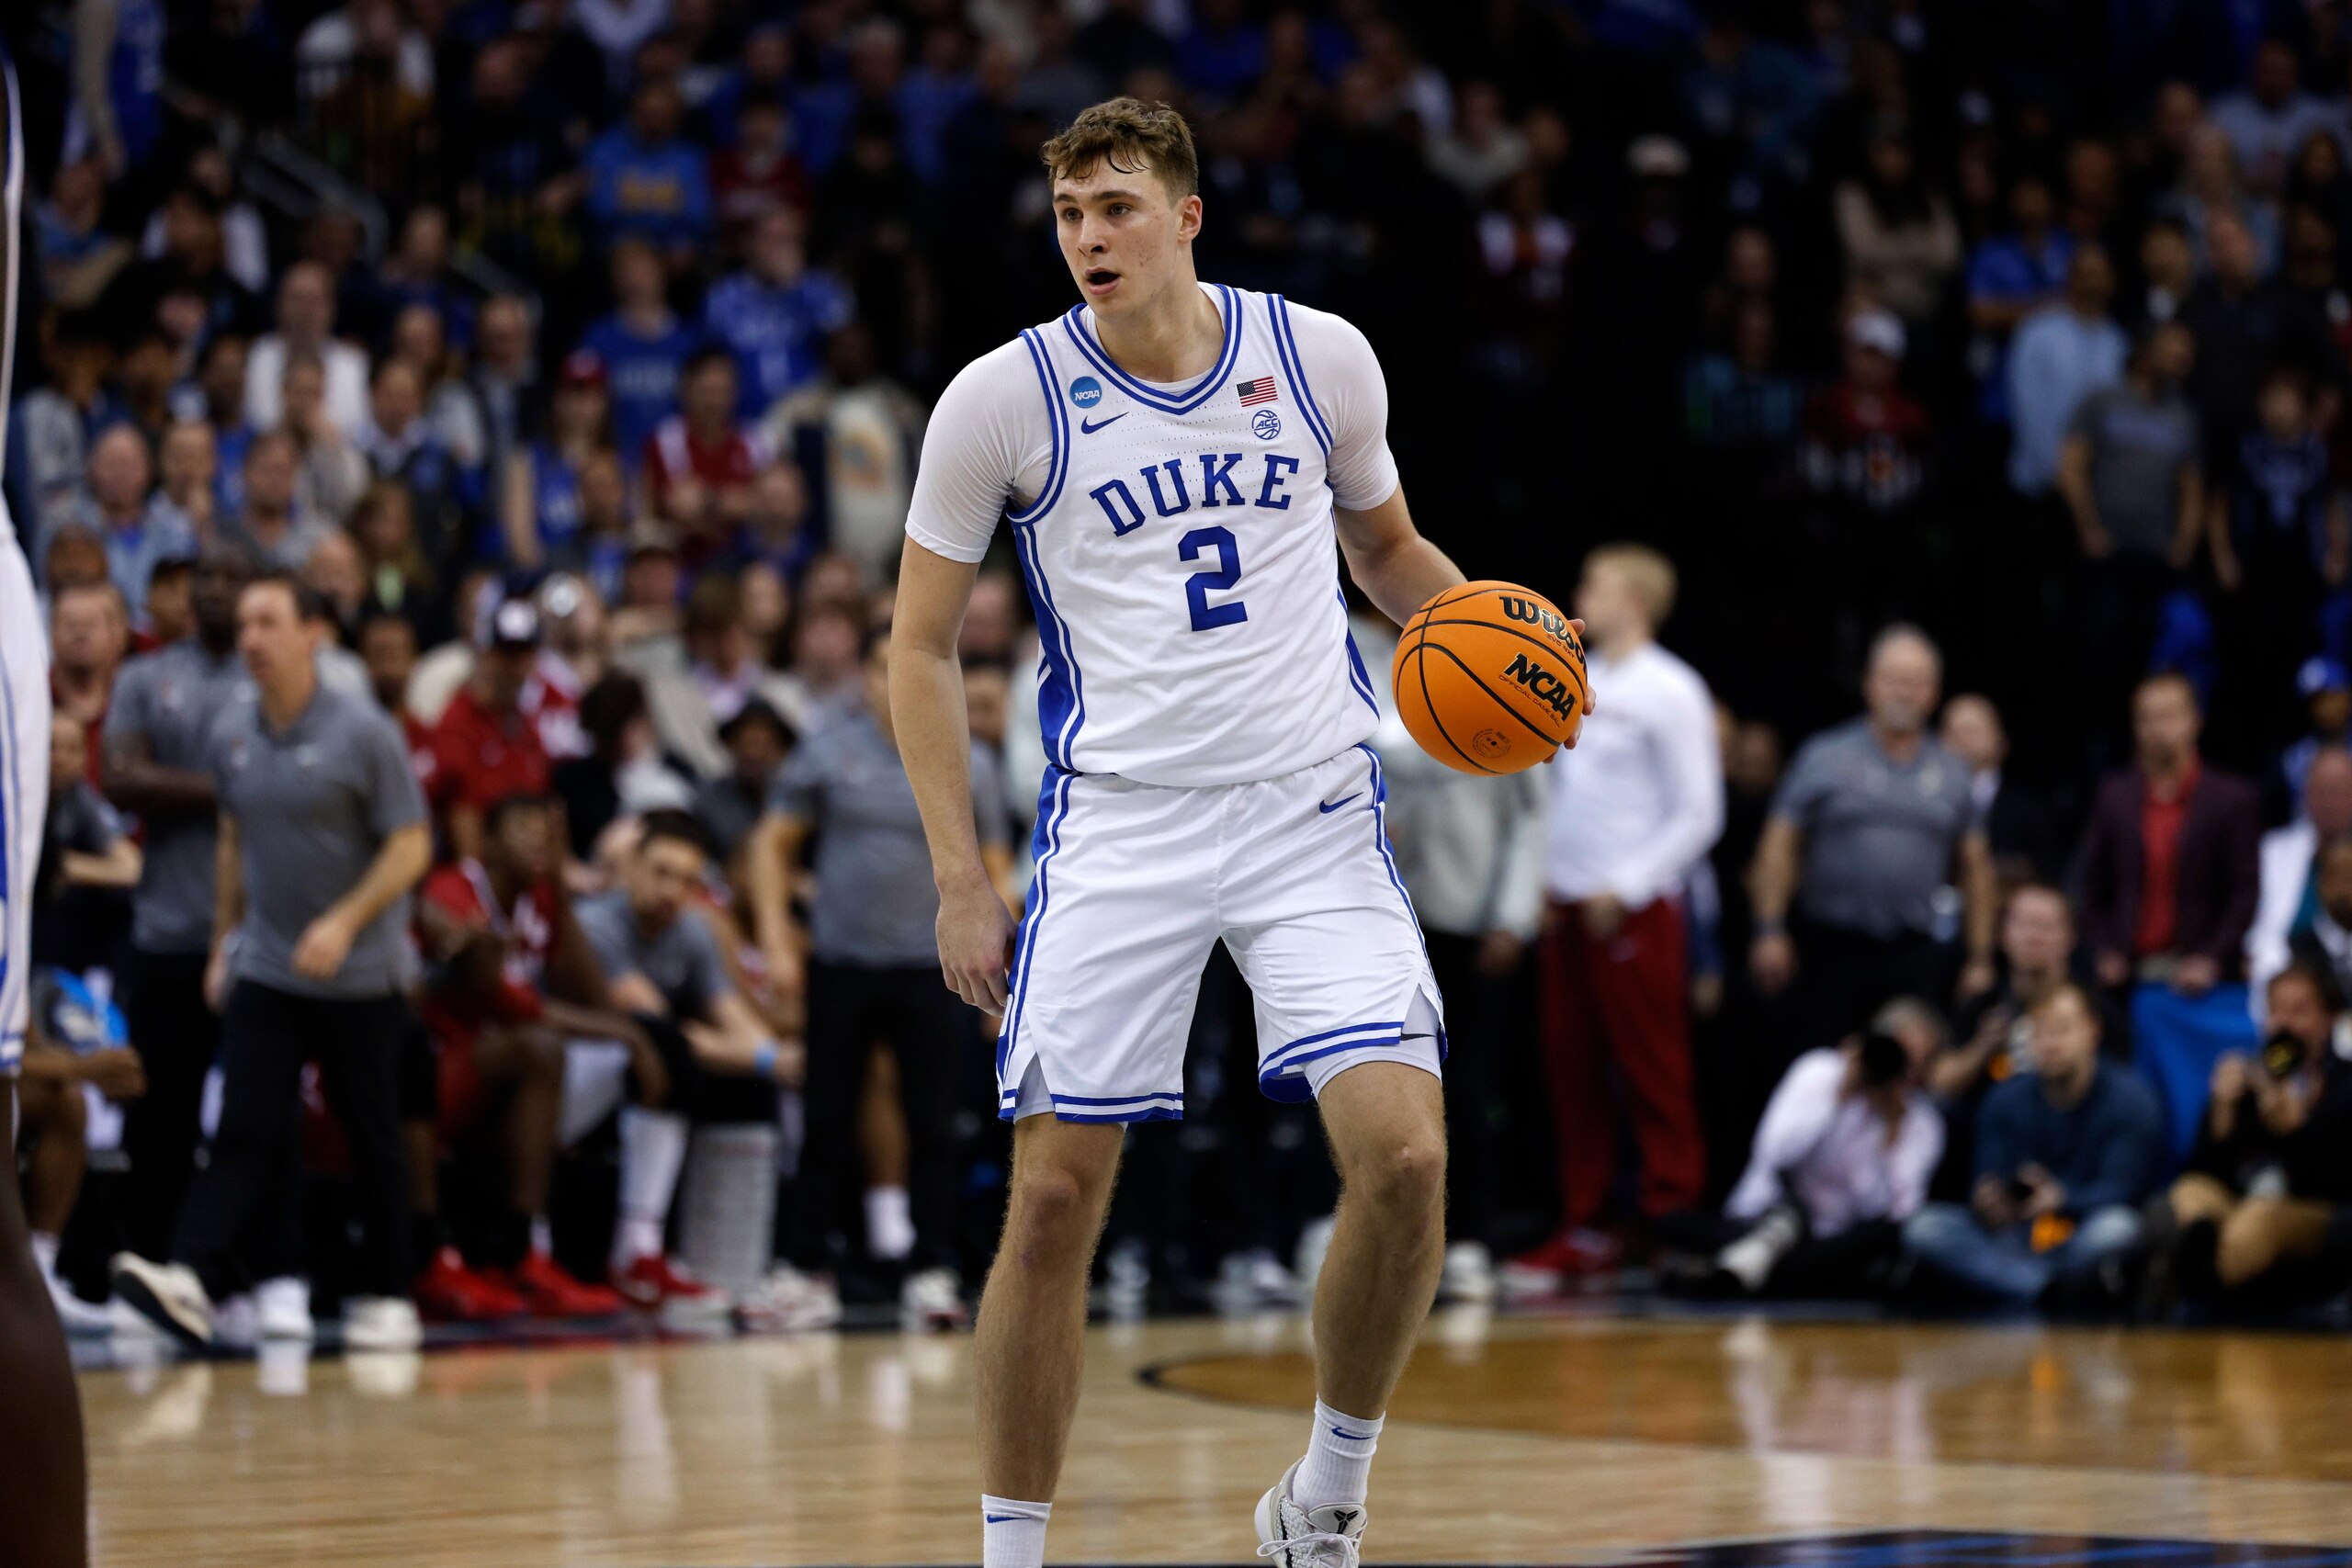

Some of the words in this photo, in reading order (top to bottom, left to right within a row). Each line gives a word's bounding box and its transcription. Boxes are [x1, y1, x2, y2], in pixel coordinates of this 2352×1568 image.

[1074, 389, 1101, 401] NCAA
[1255, 417, 1278, 429] ACC
[1089, 453, 1300, 537] DUKE
[1178, 525, 1249, 632] 2
[1498, 595, 1588, 676] Wilso
[1498, 675, 1532, 700] OFFICIAL
[1503, 652, 1576, 722] NCAA
